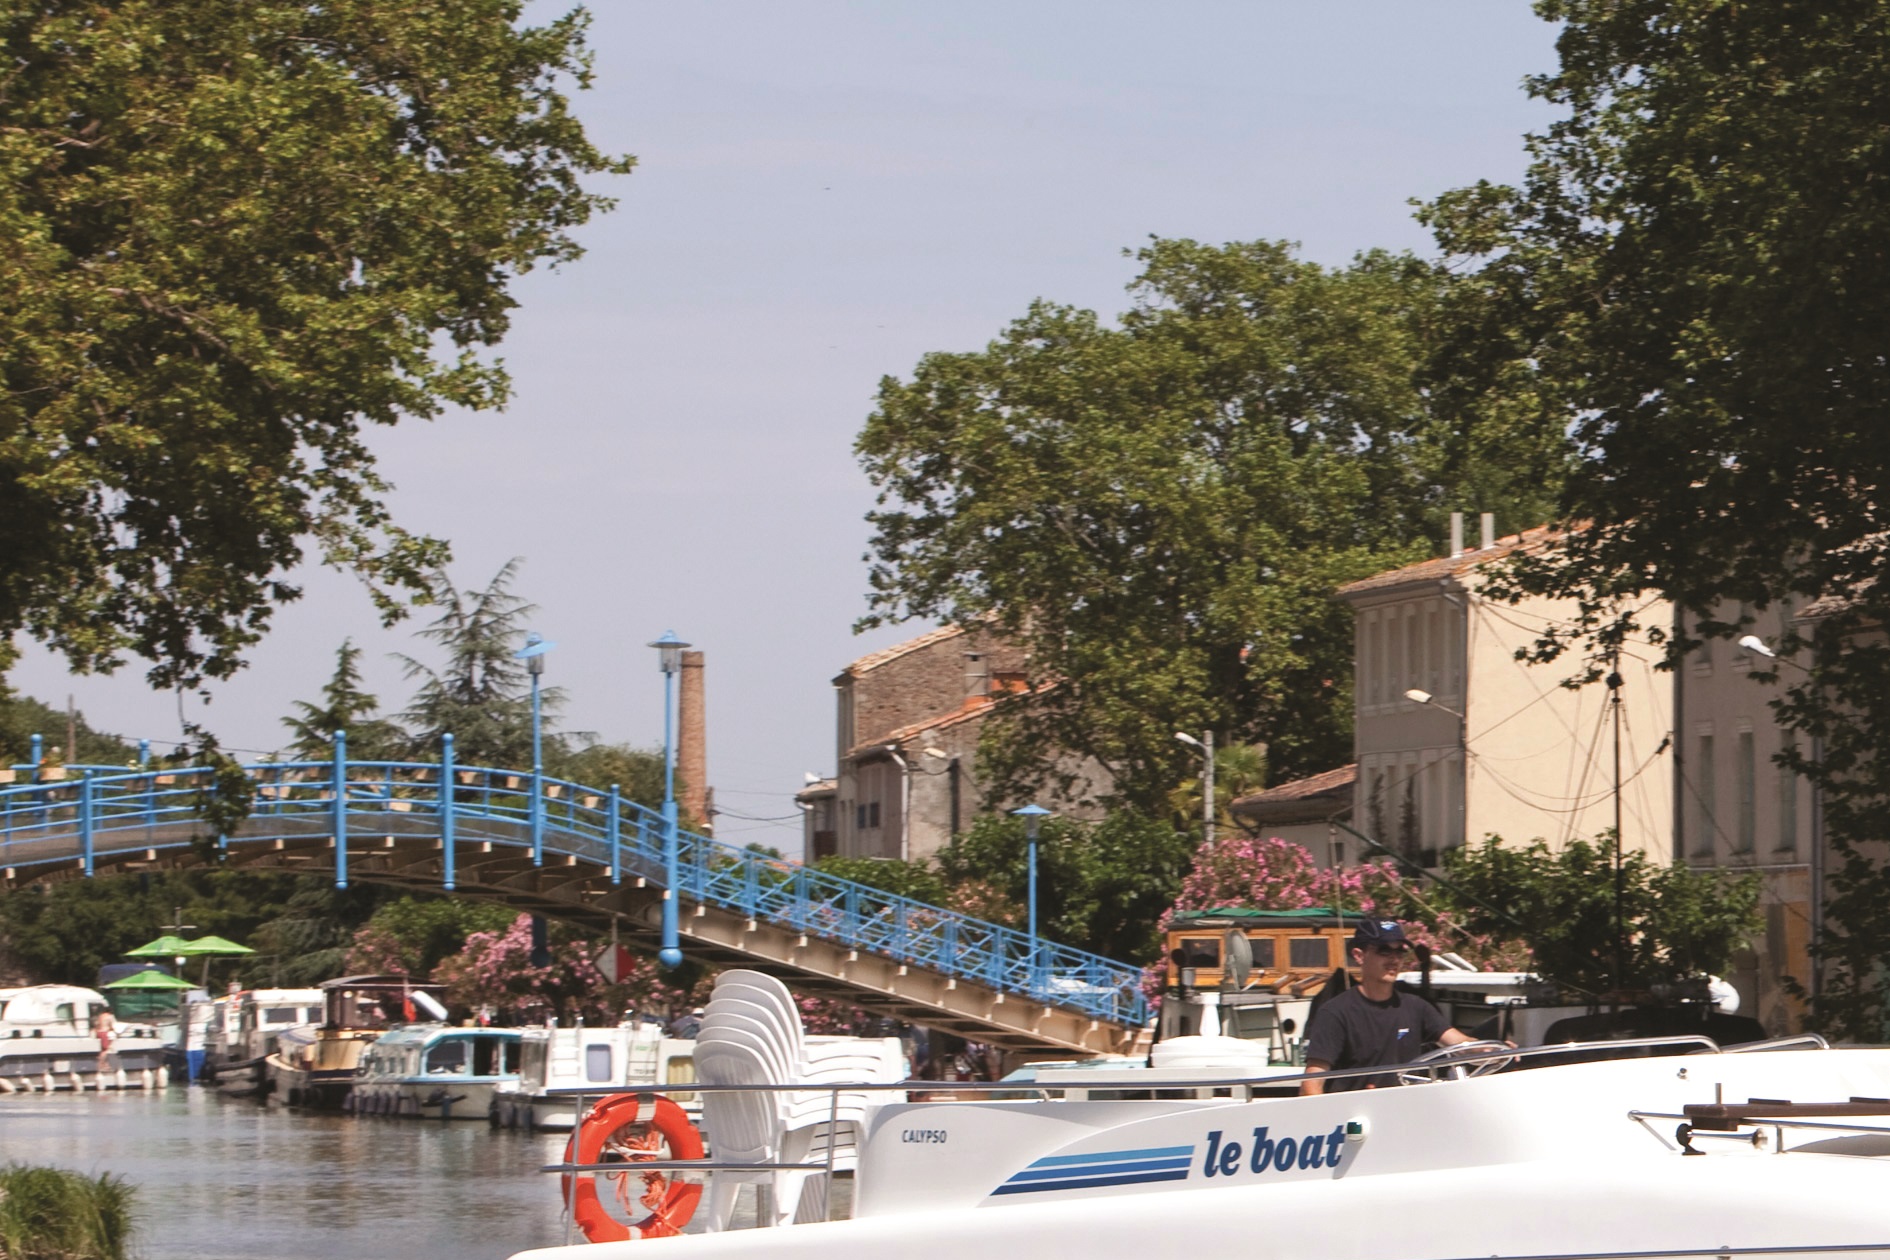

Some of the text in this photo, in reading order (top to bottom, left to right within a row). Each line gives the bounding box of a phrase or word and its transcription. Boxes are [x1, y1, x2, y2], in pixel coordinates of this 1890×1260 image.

[902, 1130, 947, 1143] CALYPSO
[1204, 1124, 1346, 1178] le boat
